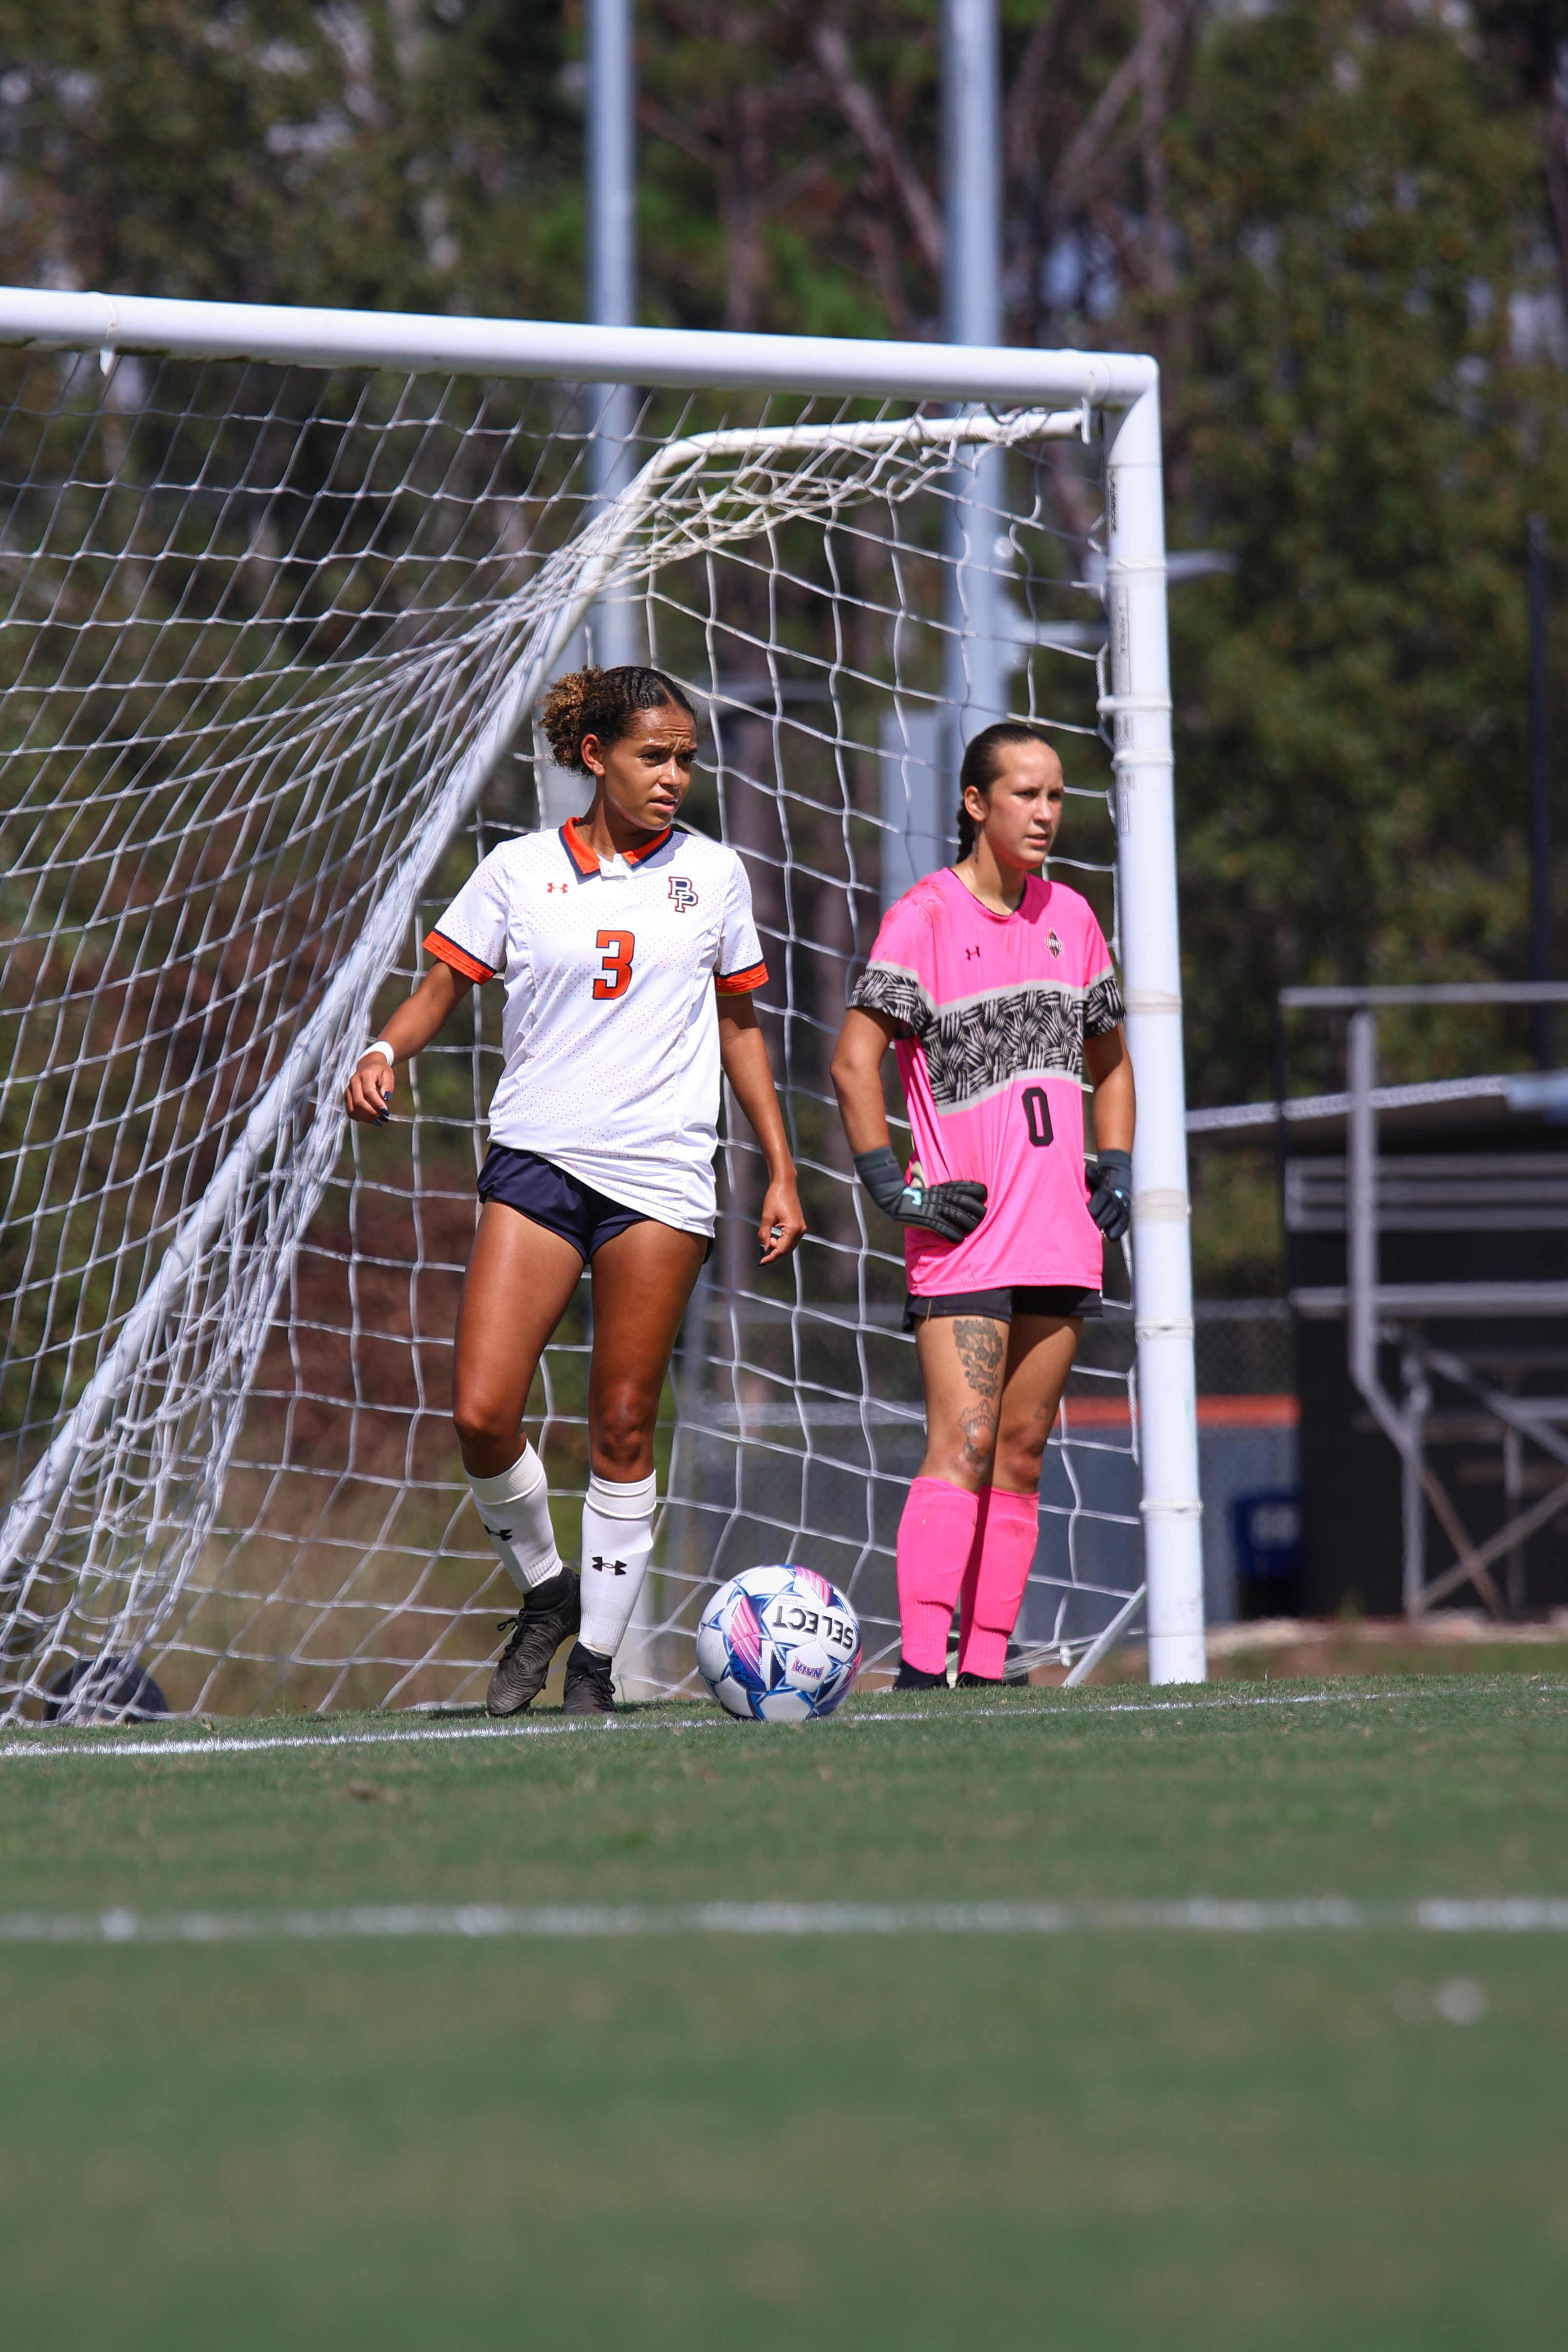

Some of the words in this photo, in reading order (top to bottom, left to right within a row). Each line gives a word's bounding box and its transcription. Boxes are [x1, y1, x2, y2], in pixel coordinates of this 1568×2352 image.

[592, 930, 635, 1000] 3
[1021, 1087, 1054, 1147] 0
[772, 1605, 854, 1651] SELECT
[794, 1659, 823, 1680] NAIA
